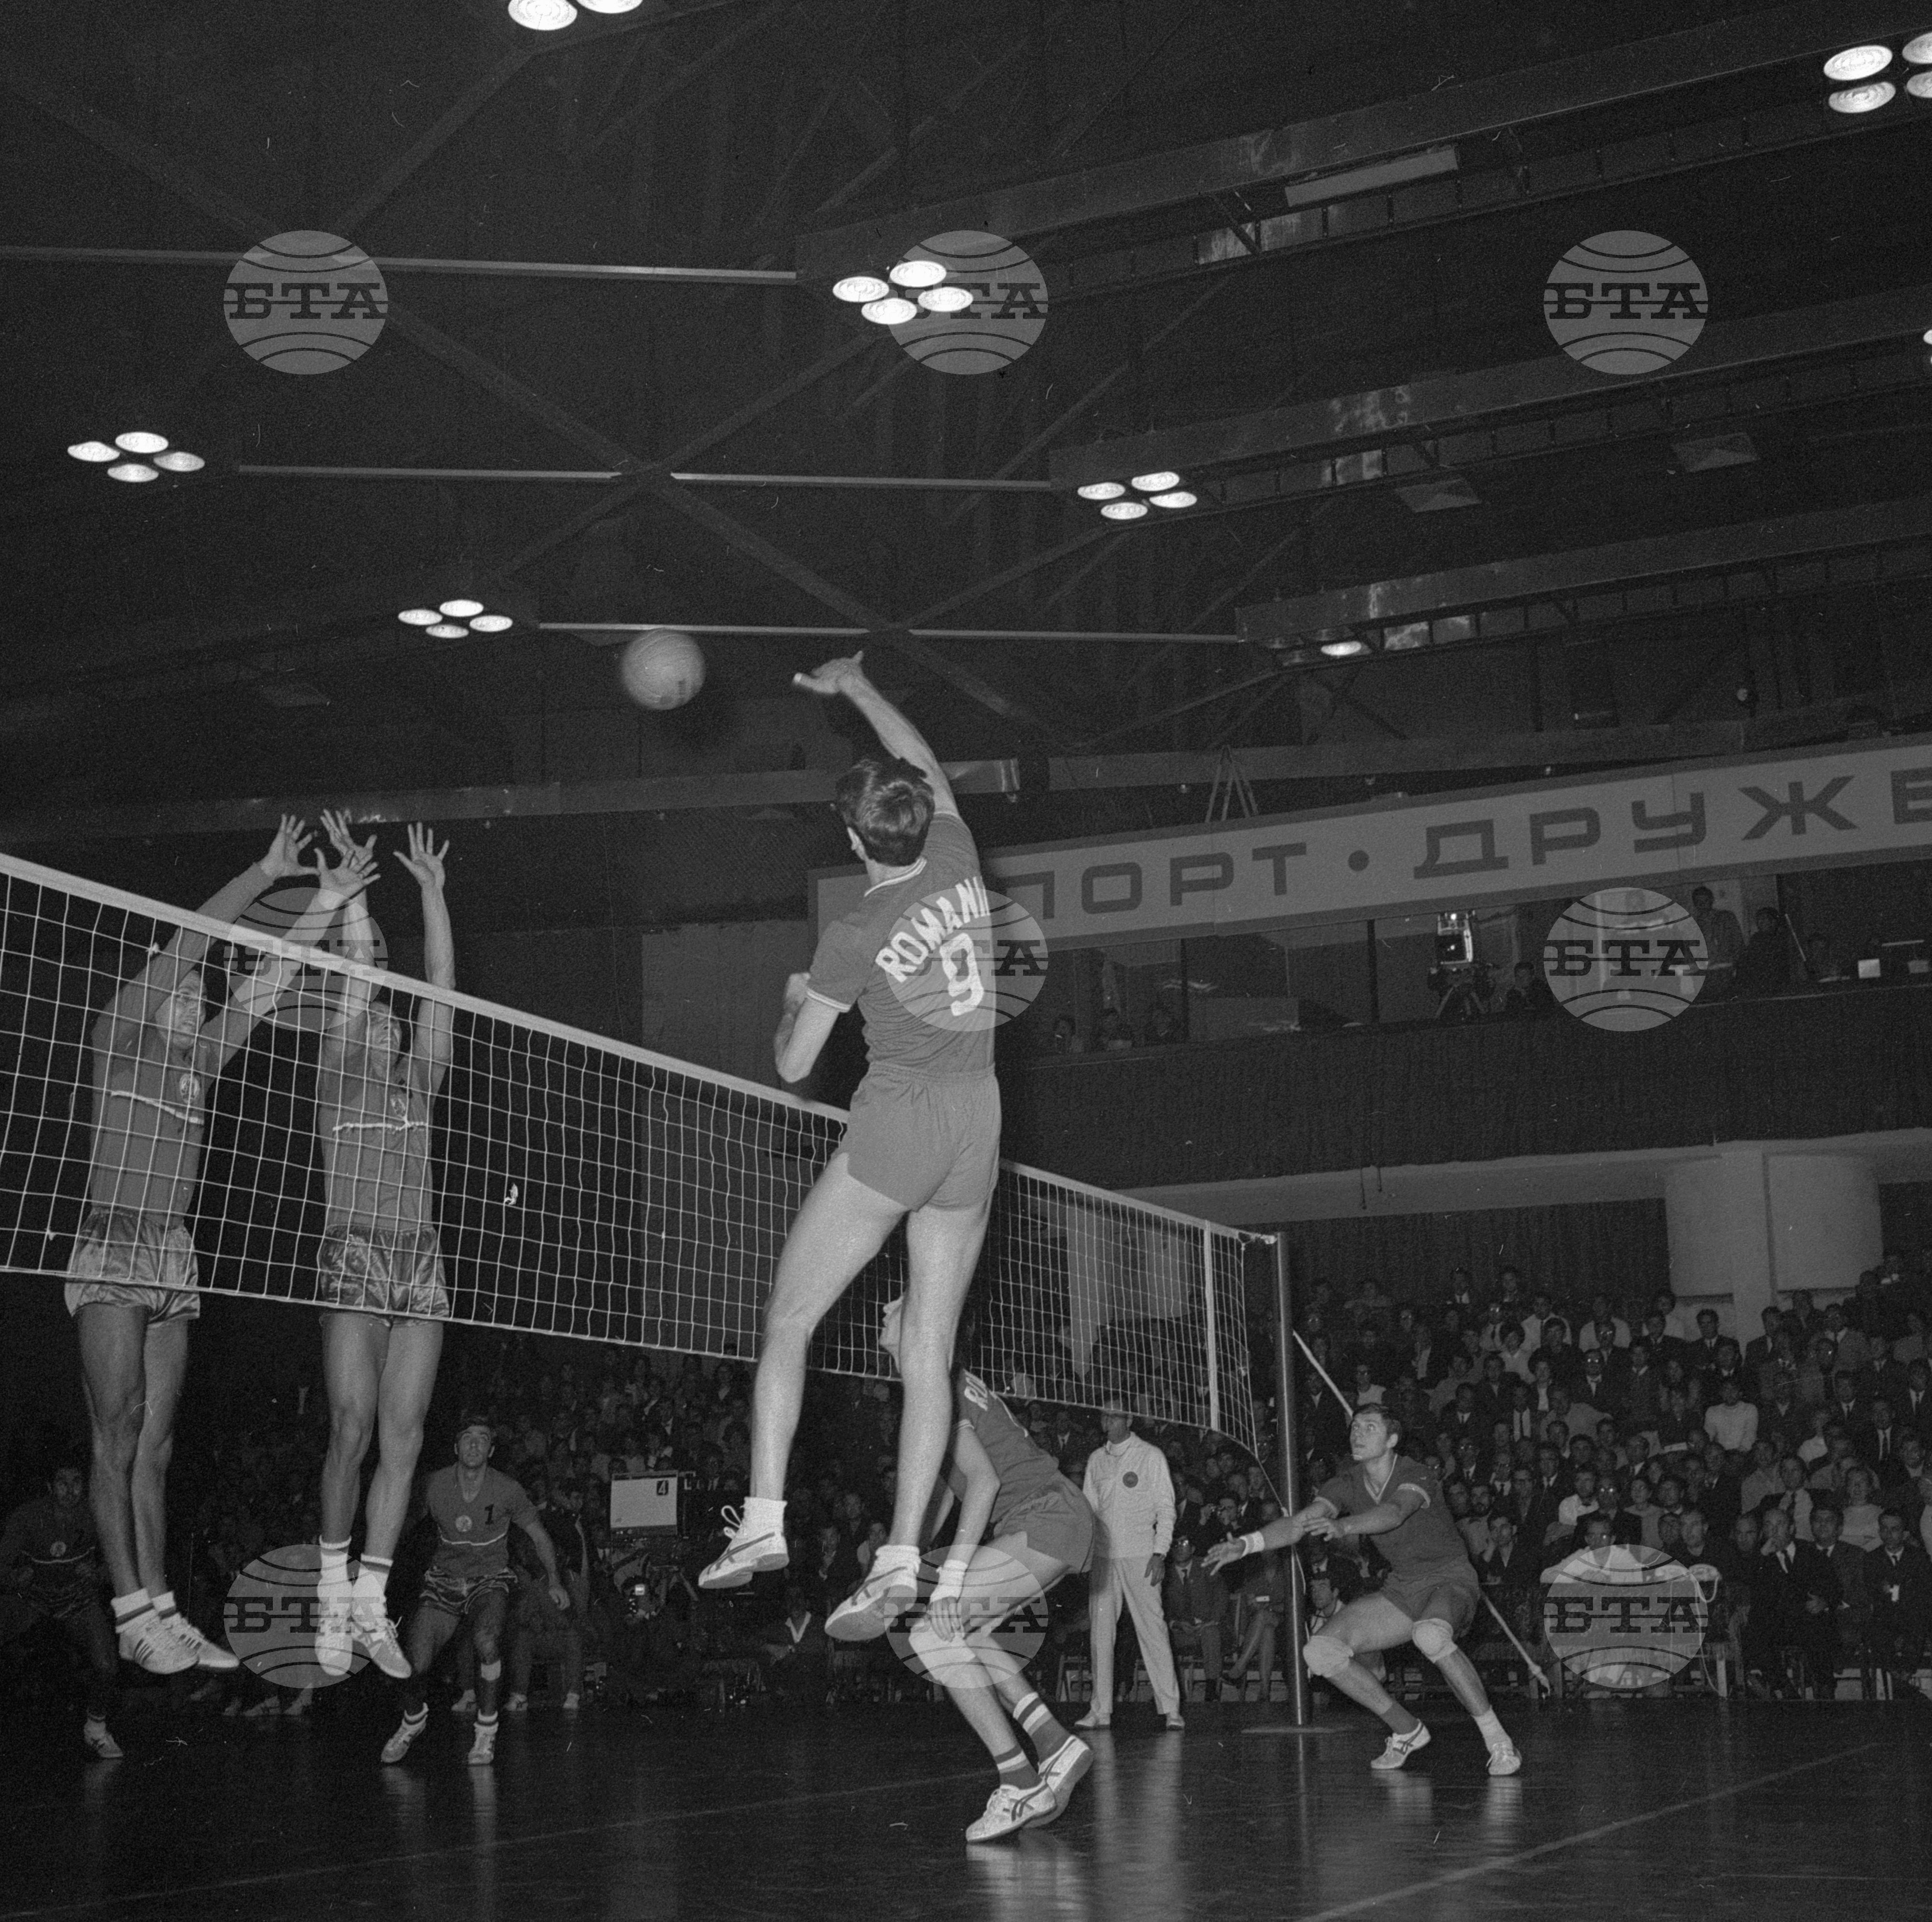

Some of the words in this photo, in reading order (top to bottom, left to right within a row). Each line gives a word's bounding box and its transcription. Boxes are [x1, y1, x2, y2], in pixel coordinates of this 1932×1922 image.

[995, 842, 1307, 923] ПОРТ
[939, 933, 984, 1016] 9
[658, 1481, 667, 1495] 4
[484, 1504, 494, 1525] 1
